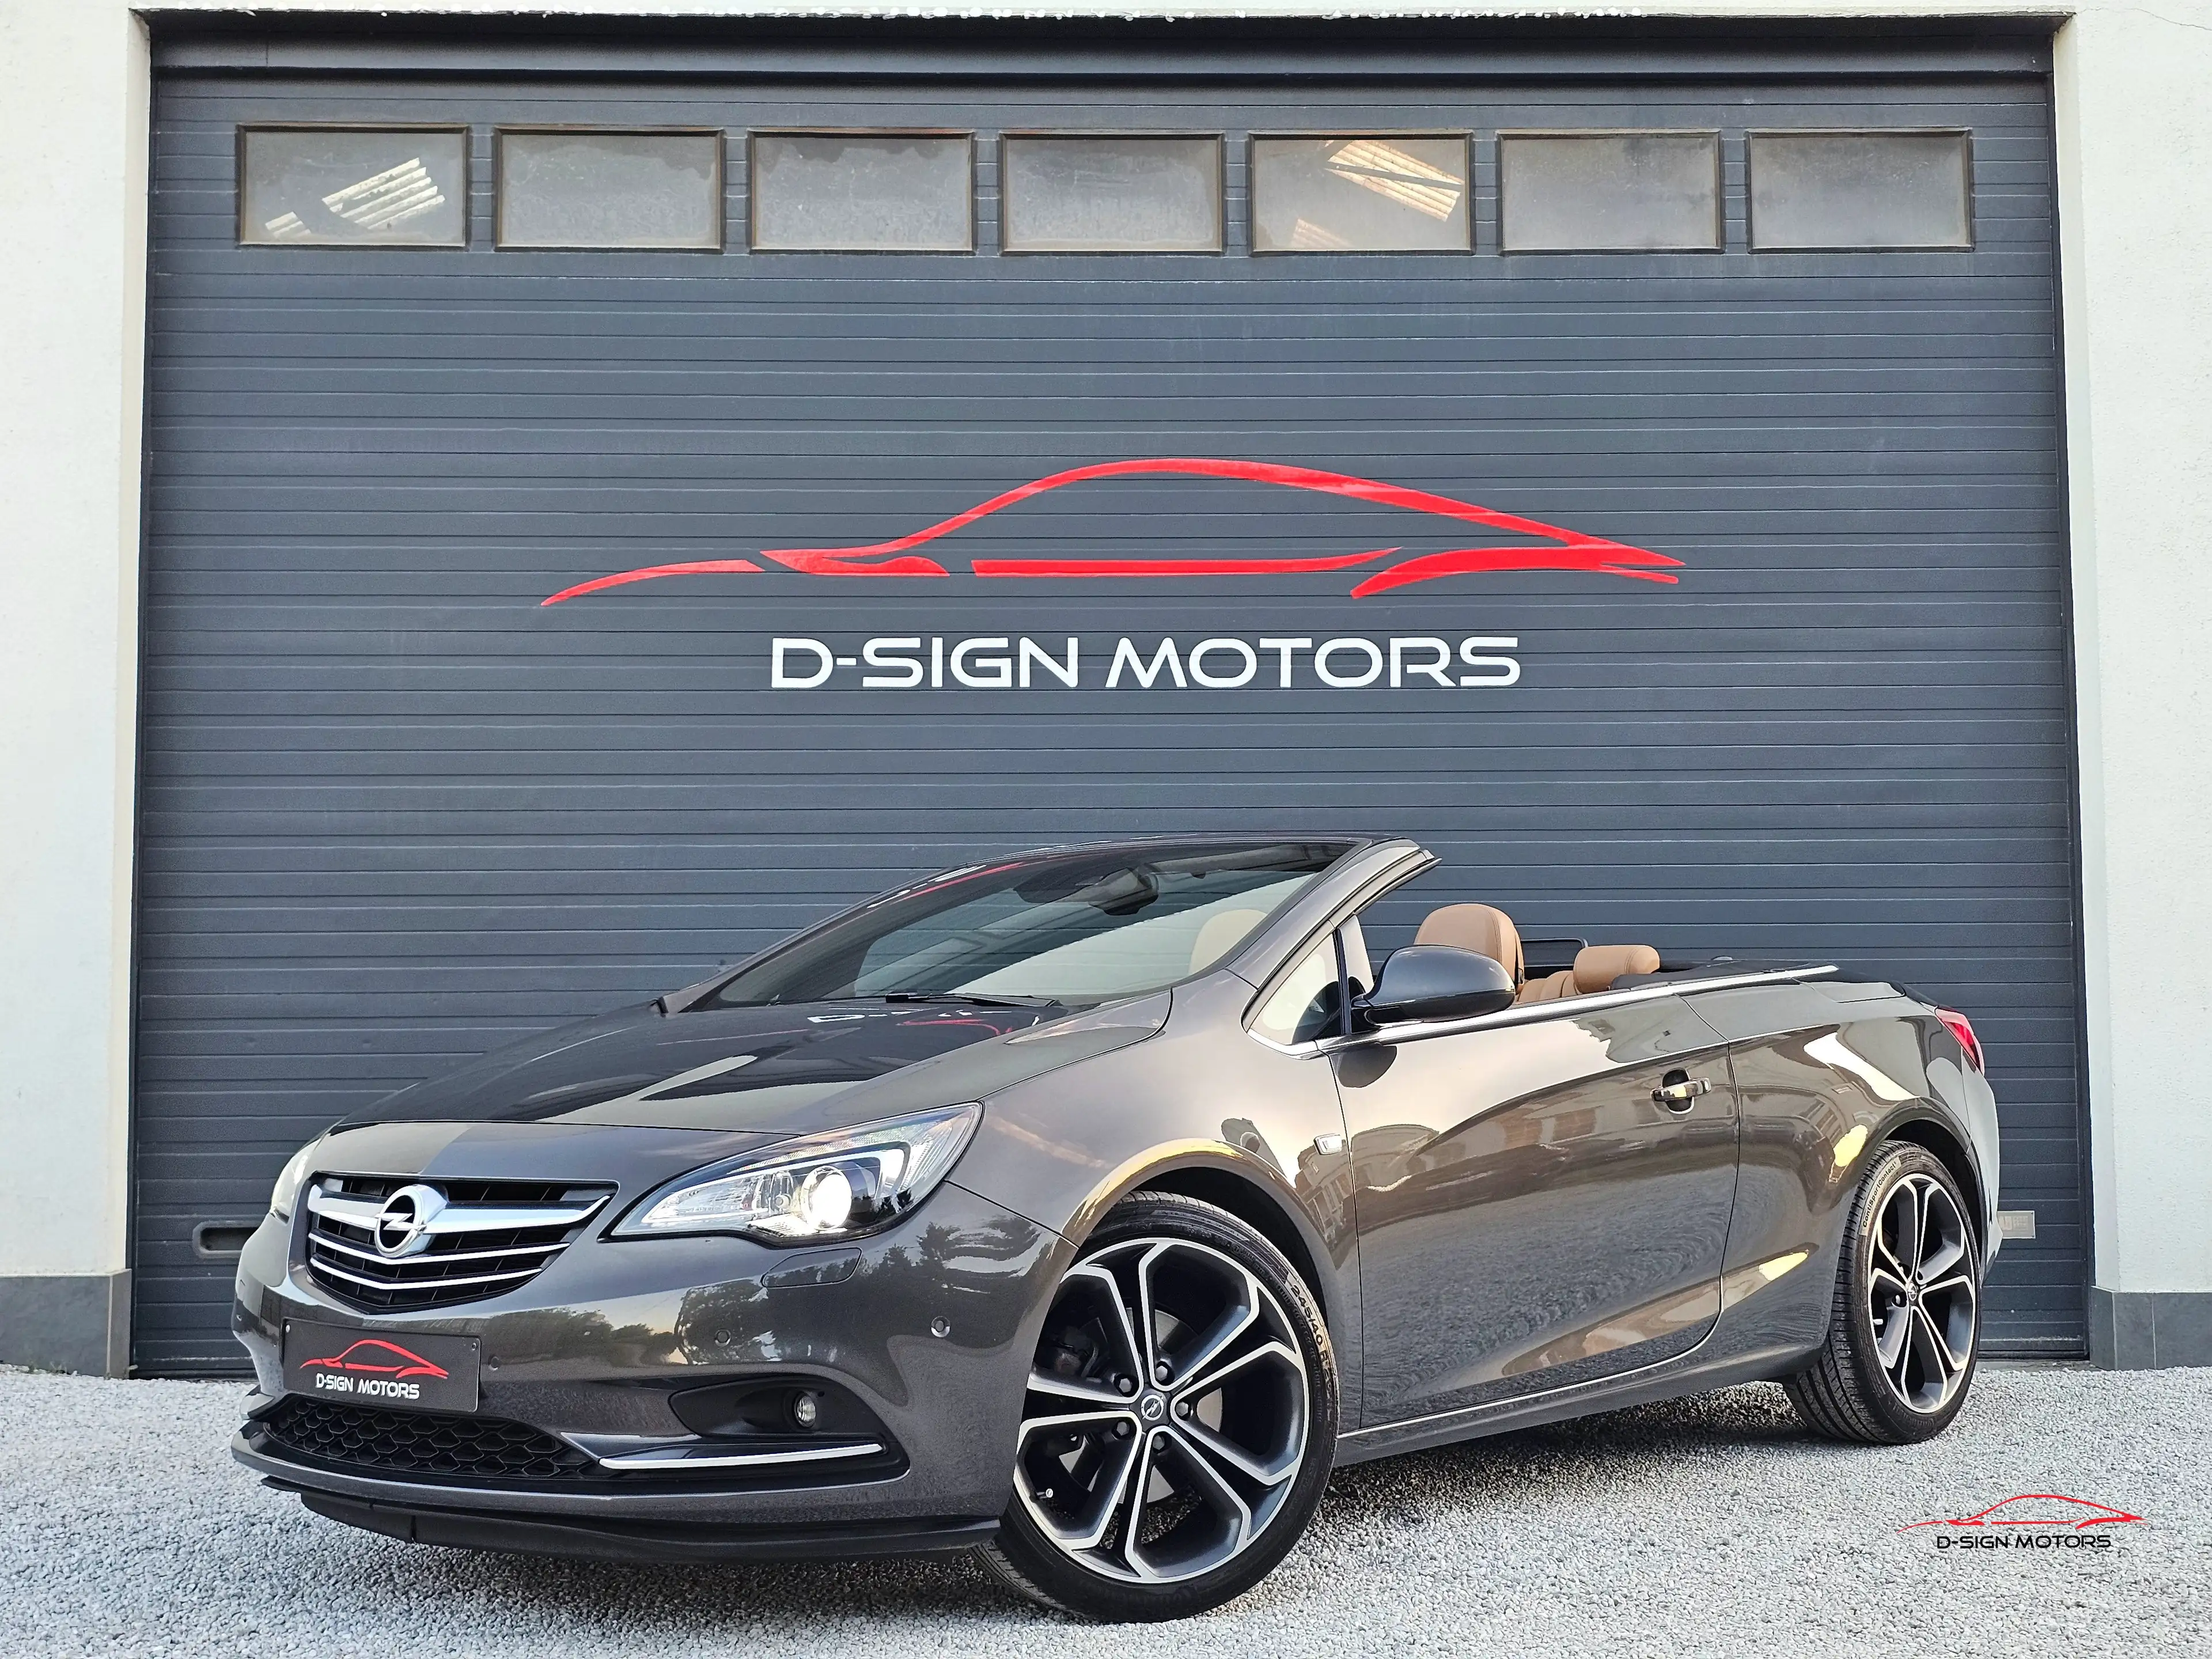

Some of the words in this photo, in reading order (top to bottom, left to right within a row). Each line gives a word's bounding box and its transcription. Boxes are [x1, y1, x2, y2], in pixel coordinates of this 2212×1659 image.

[771, 637, 1080, 689] D-SIGN
[1104, 637, 1521, 689] MOTORS
[1290, 1284, 1324, 1346] 245/40
[315, 1373, 354, 1392] D-SIGN
[357, 1377, 421, 1400] MOTORS
